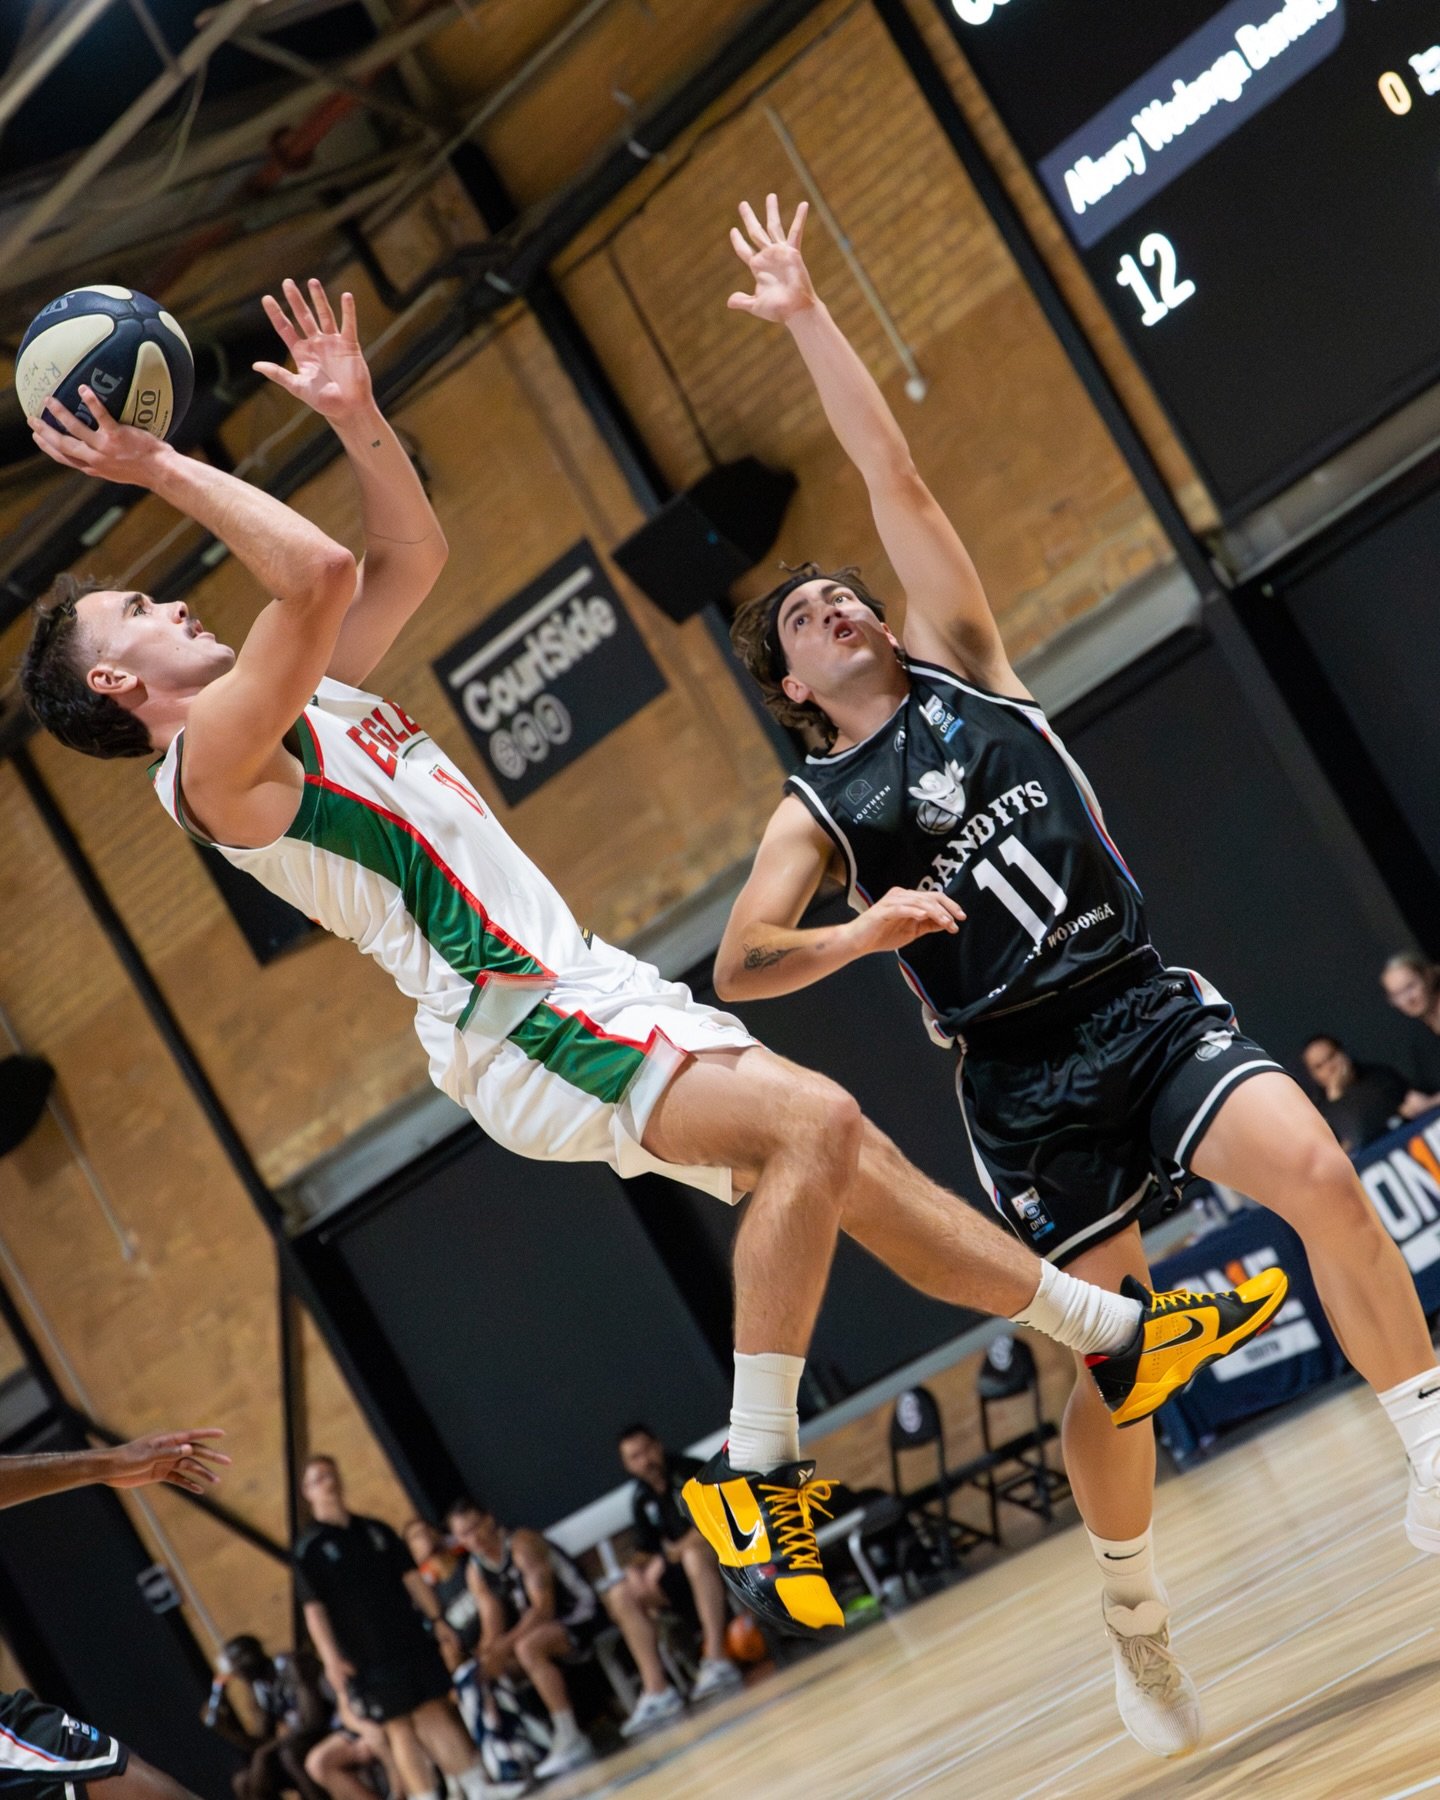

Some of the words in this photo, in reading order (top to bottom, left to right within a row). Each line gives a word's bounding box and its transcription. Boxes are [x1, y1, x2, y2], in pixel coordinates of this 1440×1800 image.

[1378, 71, 1412, 115] 0
[1116, 233, 1196, 327] 12
[939, 712, 956, 733] ONE
[853, 785, 891, 825] SOUTHERN
[917, 780, 1049, 895] BANDITS
[971, 834, 1068, 946] 11
[1047, 902, 1115, 949] WODONGA
